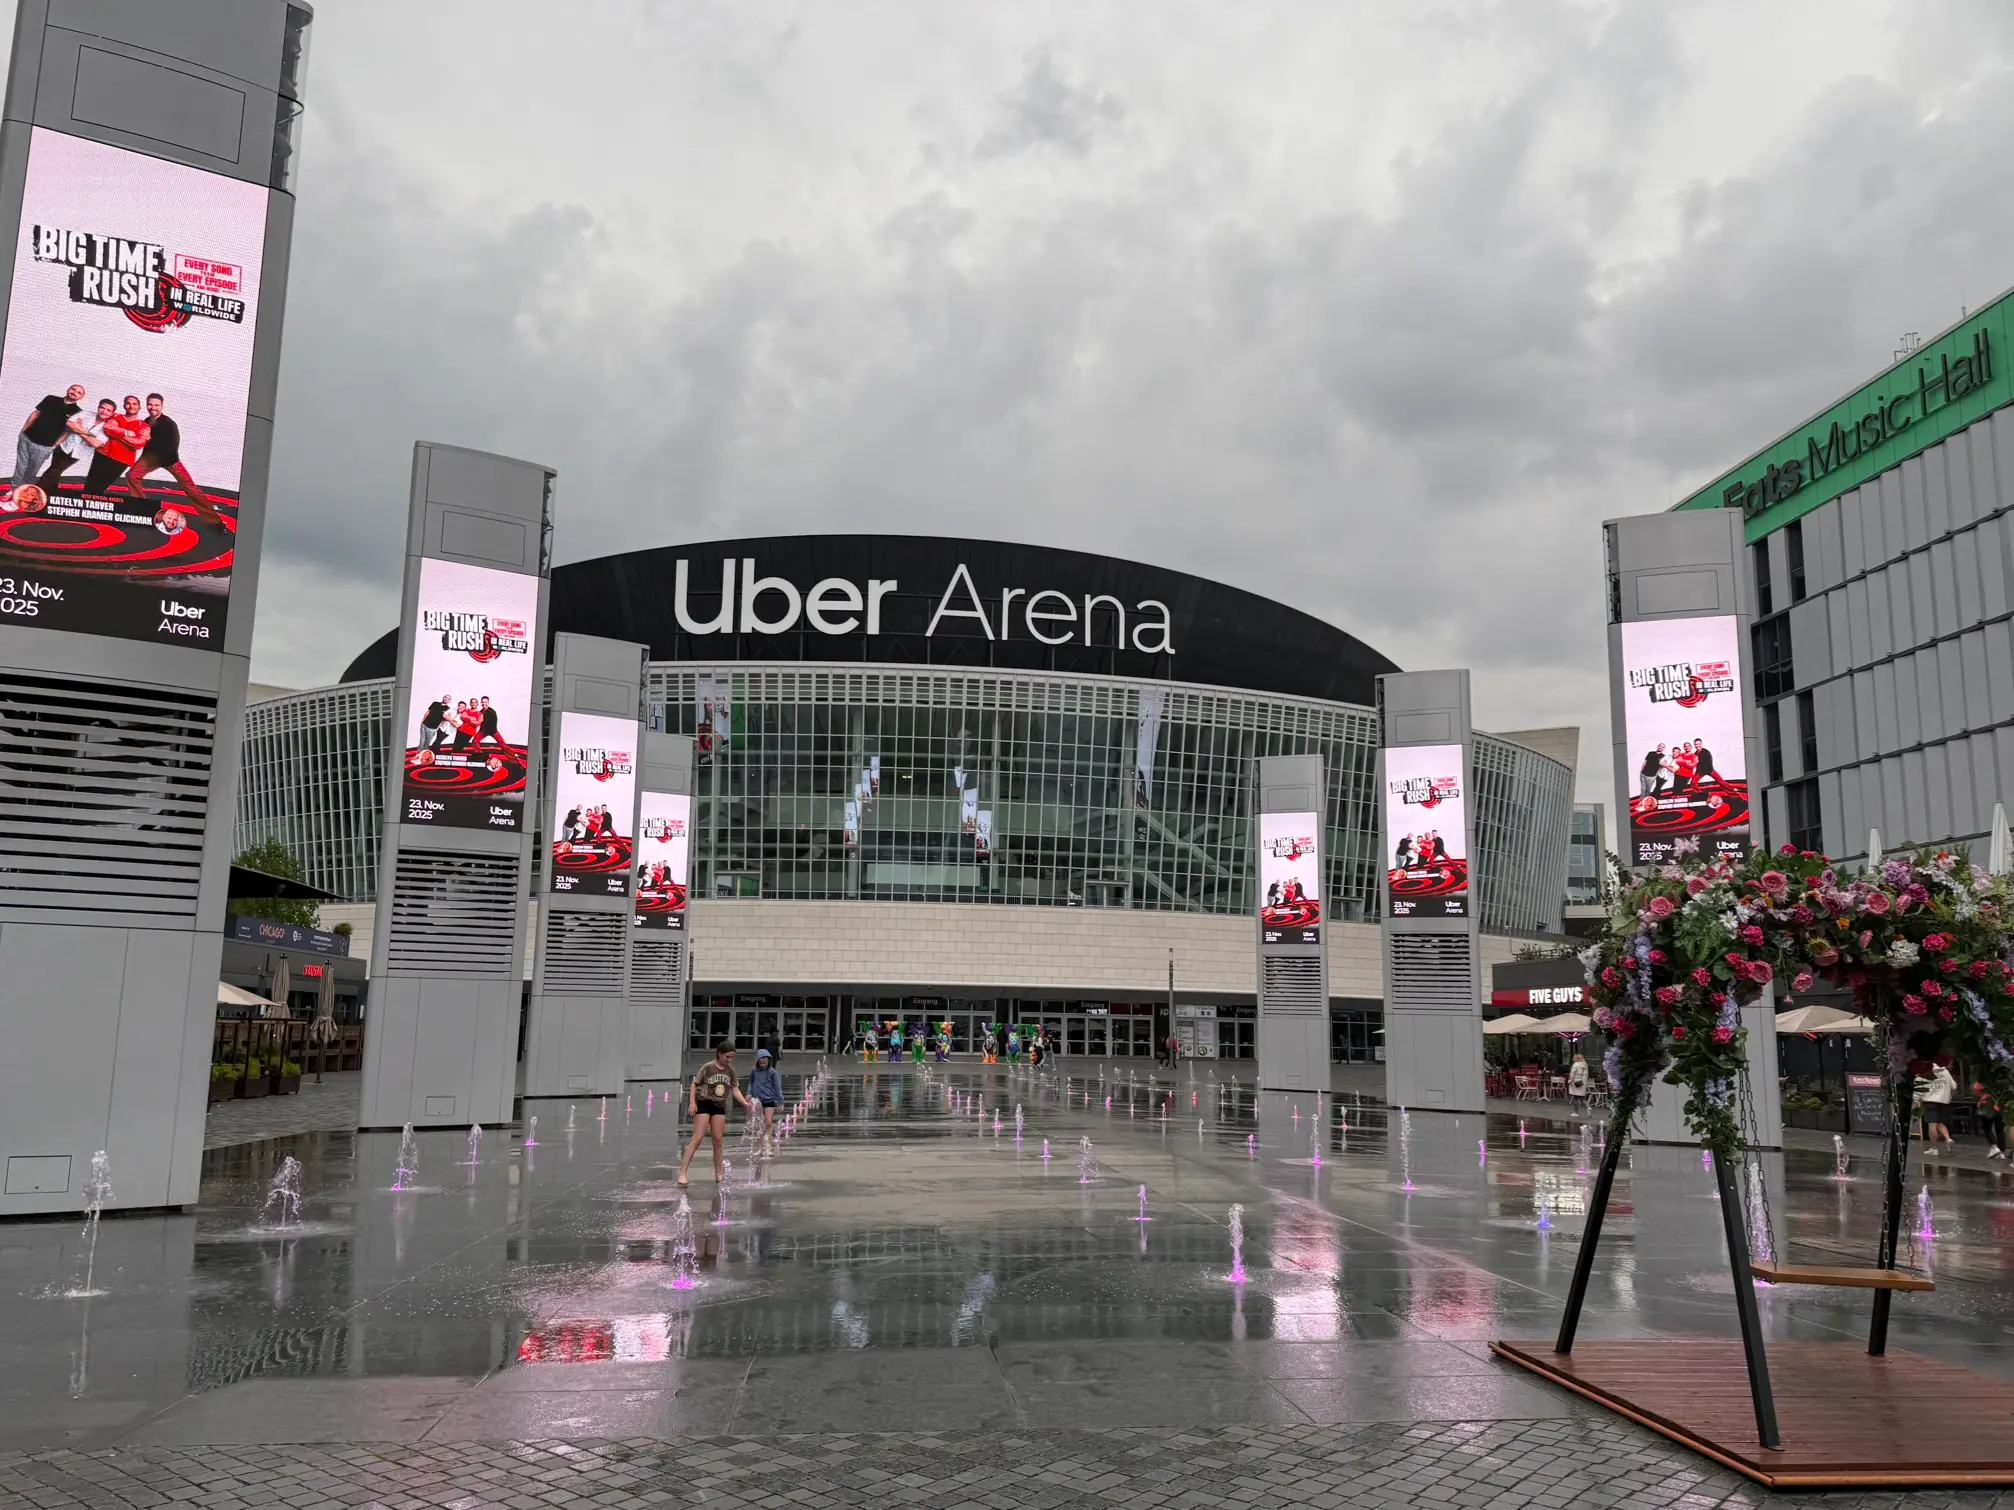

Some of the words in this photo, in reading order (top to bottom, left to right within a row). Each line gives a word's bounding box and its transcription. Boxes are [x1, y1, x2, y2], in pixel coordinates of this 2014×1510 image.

[39, 226, 87, 265] BIG
[92, 236, 162, 278] TIME
[184, 259, 209, 271] EVERY
[211, 264, 232, 276] SONG
[83, 266, 156, 308] RUSH
[178, 272, 202, 284] EVERY
[205, 277, 238, 291] EPISODE
[170, 287, 183, 301] IN
[186, 290, 214, 309] REAL
[218, 298, 241, 314] LIFE
[1723, 459, 1801, 517] Eats
[1808, 395, 1912, 481] Music
[1918, 327, 1992, 417] Hall
[49, 495, 84, 508] KATELYN
[85, 499, 115, 511] TARVER
[47, 505, 80, 517] STEPHEN
[81, 509, 113, 521] KRAMER
[114, 513, 153, 526] GLICKMAN
[22, 580, 65, 601] Nov.
[160, 599, 206, 620] Uber
[674, 558, 898, 635] Uber
[925, 563, 1176, 655] Arena
[158, 618, 210, 638] Arena
[427, 610, 450, 631] BIG
[451, 612, 487, 634] TIME
[448, 631, 484, 651] RUSH
[1633, 668, 1656, 686] BIG
[1657, 663, 1691, 683] TIME
[1655, 680, 1691, 700] RUSH
[565, 748, 581, 761] BIG
[582, 748, 605, 762] TIME
[580, 760, 604, 774] RUSH
[1392, 780, 1408, 793] BIG
[1408, 777, 1431, 791] TIME
[1407, 789, 1430, 803] RUSH
[408, 809, 433, 820] 2025
[424, 801, 445, 811] Nov.
[489, 806, 513, 816] Uber
[488, 816, 515, 826] Arena
[1716, 841, 1739, 849] Uber
[1529, 988, 1551, 1004] FIVE
[1553, 986, 1583, 1003] GUYS
